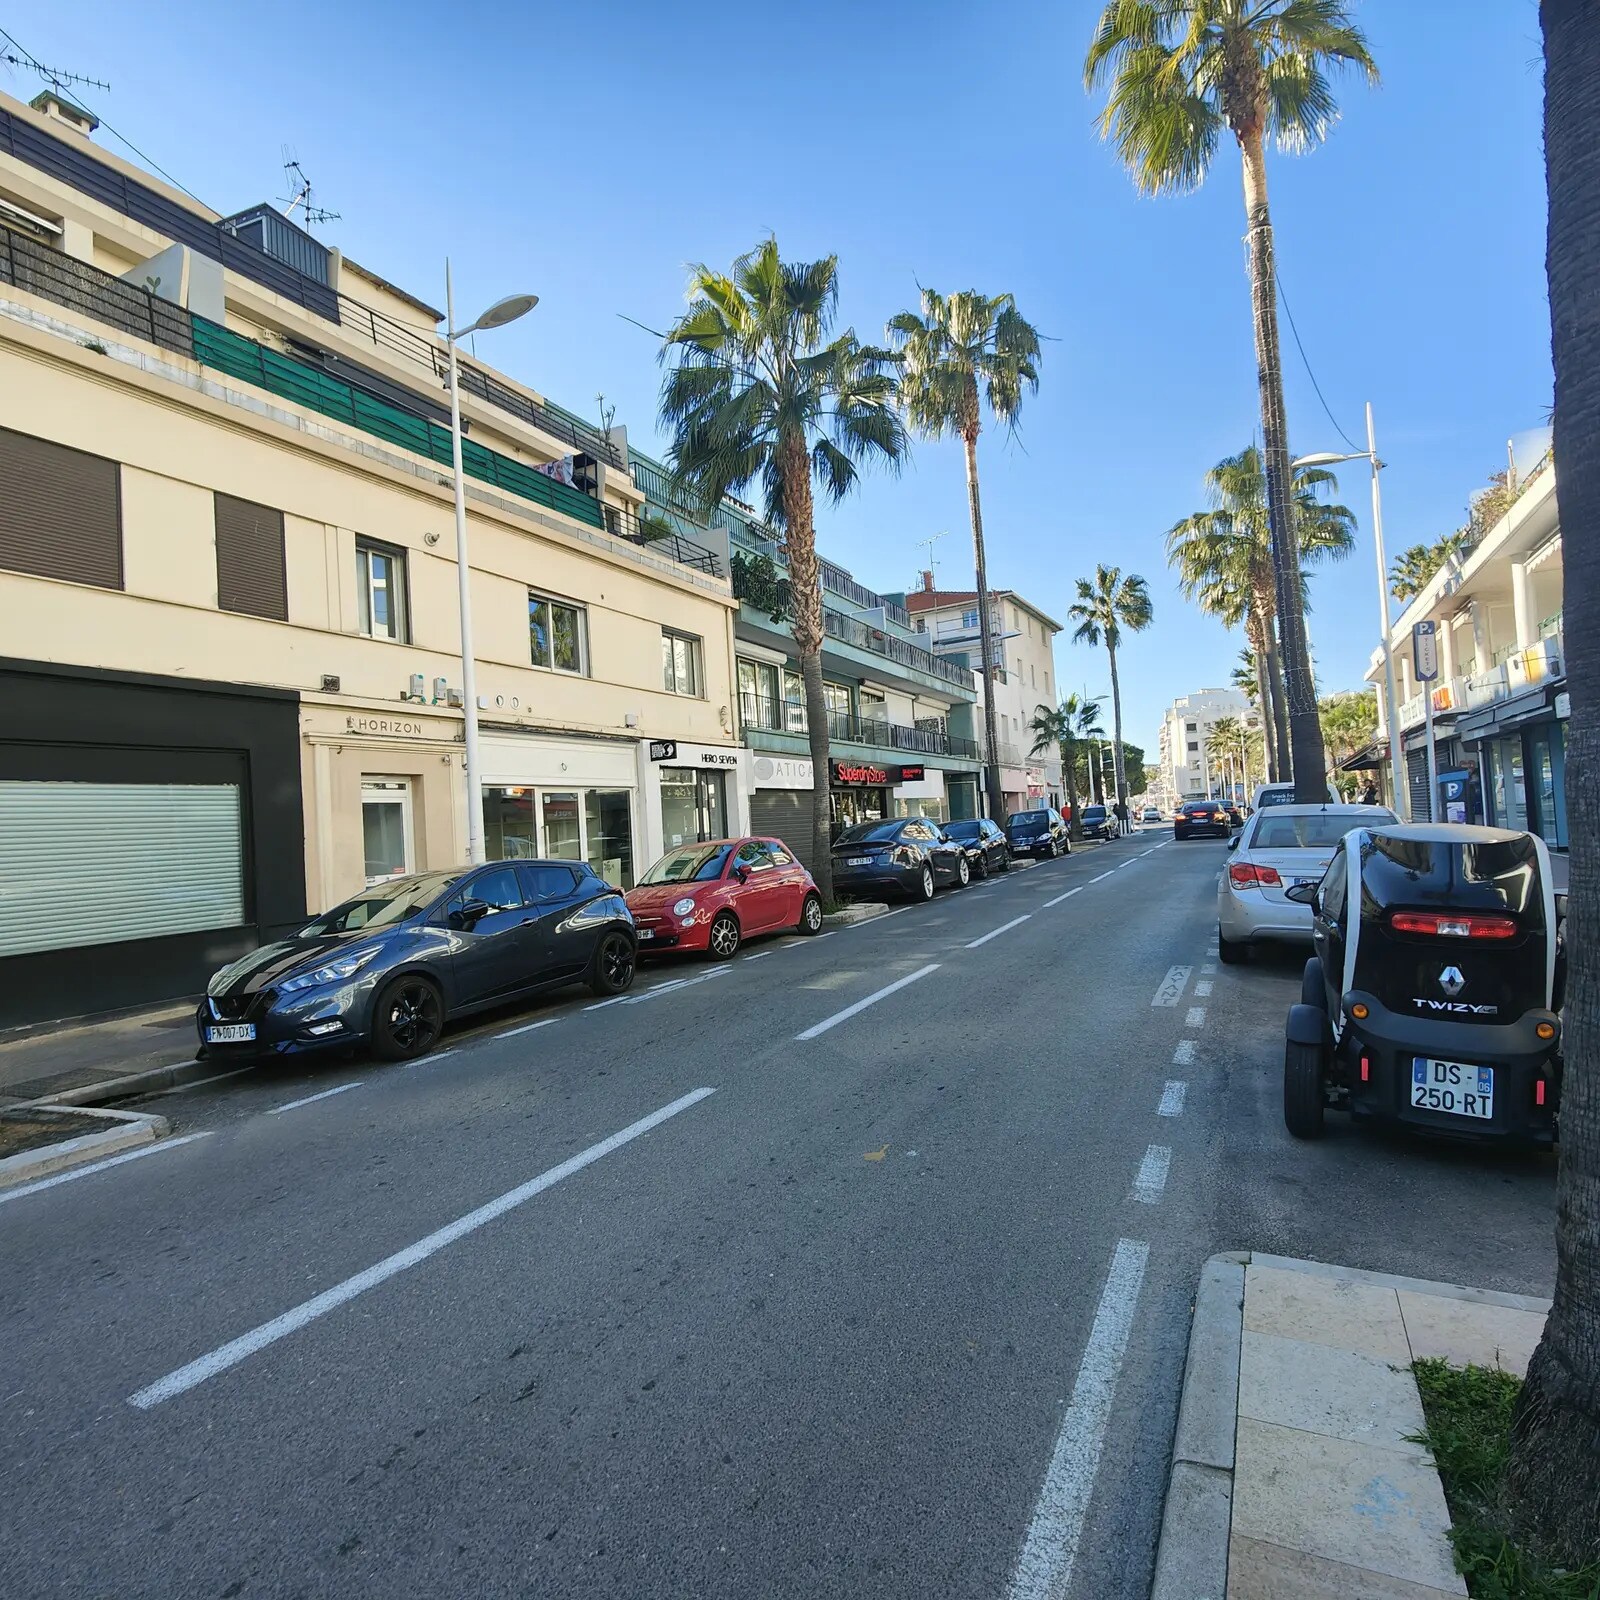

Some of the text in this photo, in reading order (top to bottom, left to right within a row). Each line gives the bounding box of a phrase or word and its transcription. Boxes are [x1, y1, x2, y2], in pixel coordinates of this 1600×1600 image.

[1420, 623, 1429, 634] P
[1423, 637, 1431, 671] TICKETS
[701, 753, 738, 765] HERO SEVEN
[1448, 783, 1458, 797] P
[1412, 998, 1483, 1014] TWIZY
[1478, 1081, 1490, 1092] 06
[1415, 1087, 1490, 1115] 250-RT
